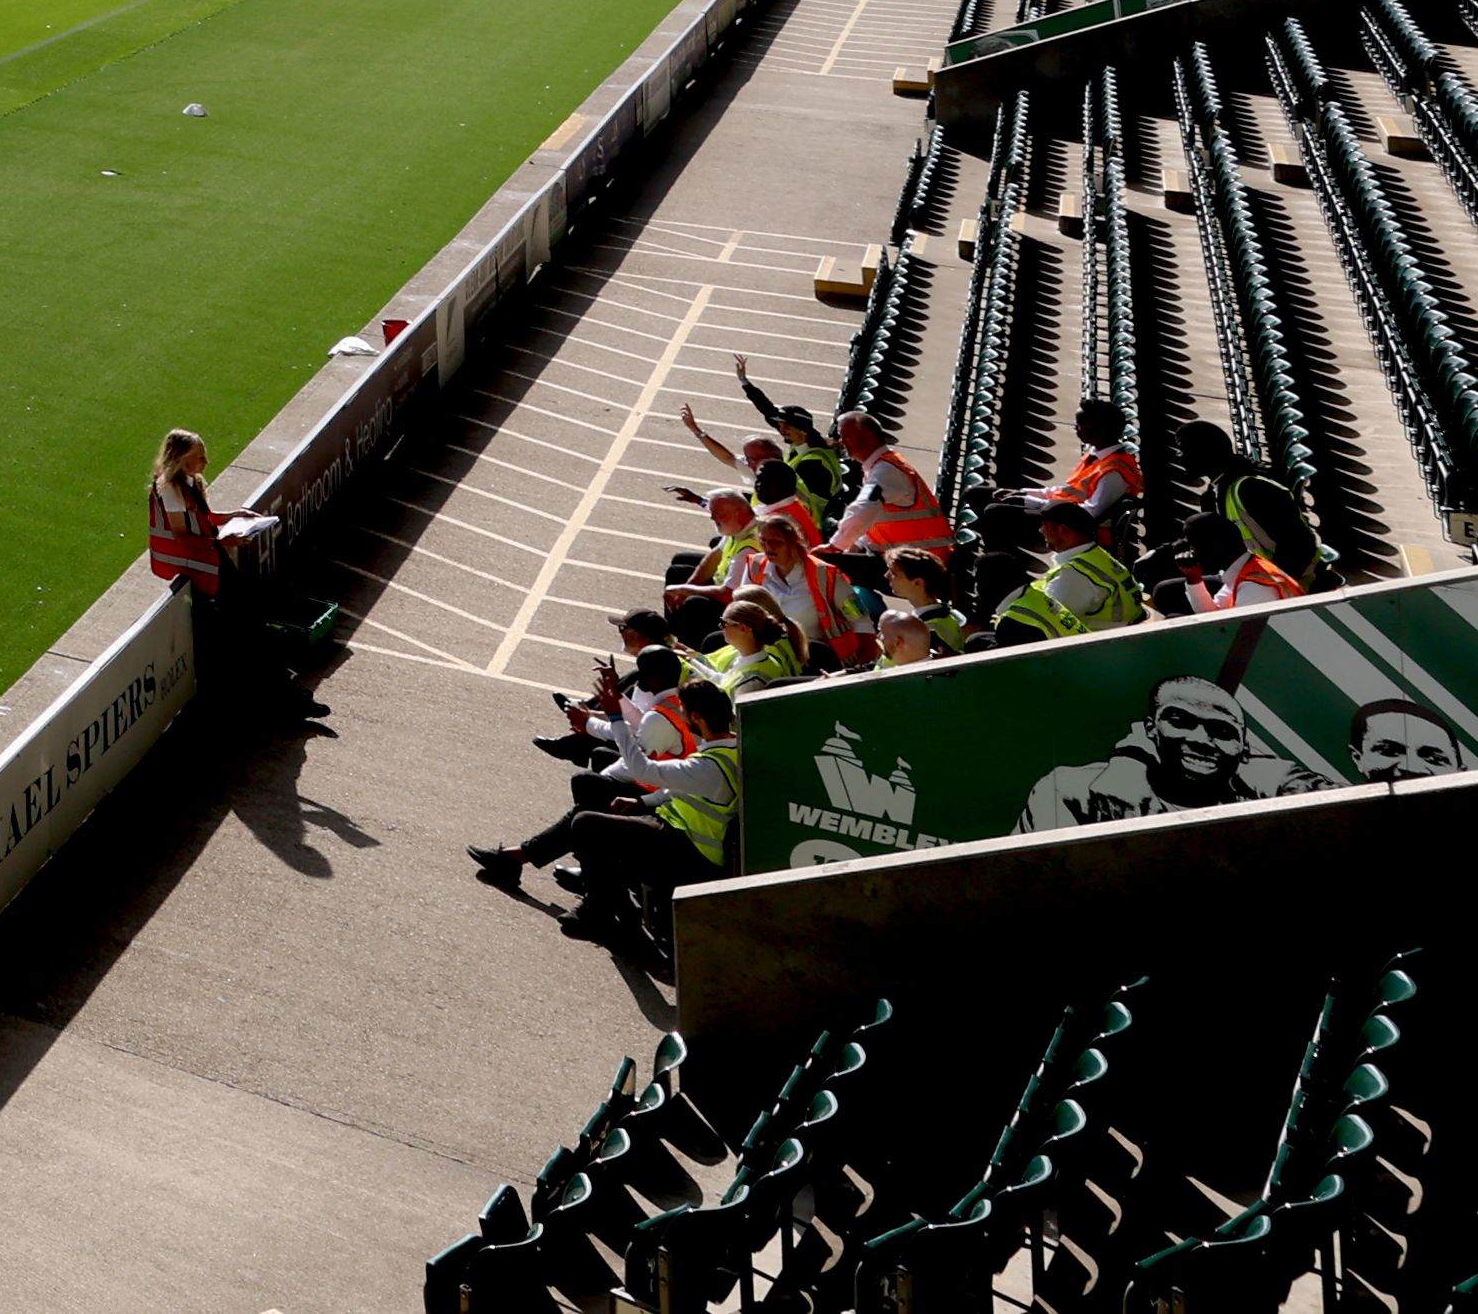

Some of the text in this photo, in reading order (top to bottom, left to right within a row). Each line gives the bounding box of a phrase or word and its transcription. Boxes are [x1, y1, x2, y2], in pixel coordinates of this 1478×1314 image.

[286, 457, 341, 543] Bathroom
[345, 438, 354, 478] &
[67, 663, 156, 789] SPIERS
[160, 652, 188, 702] ROLEX
